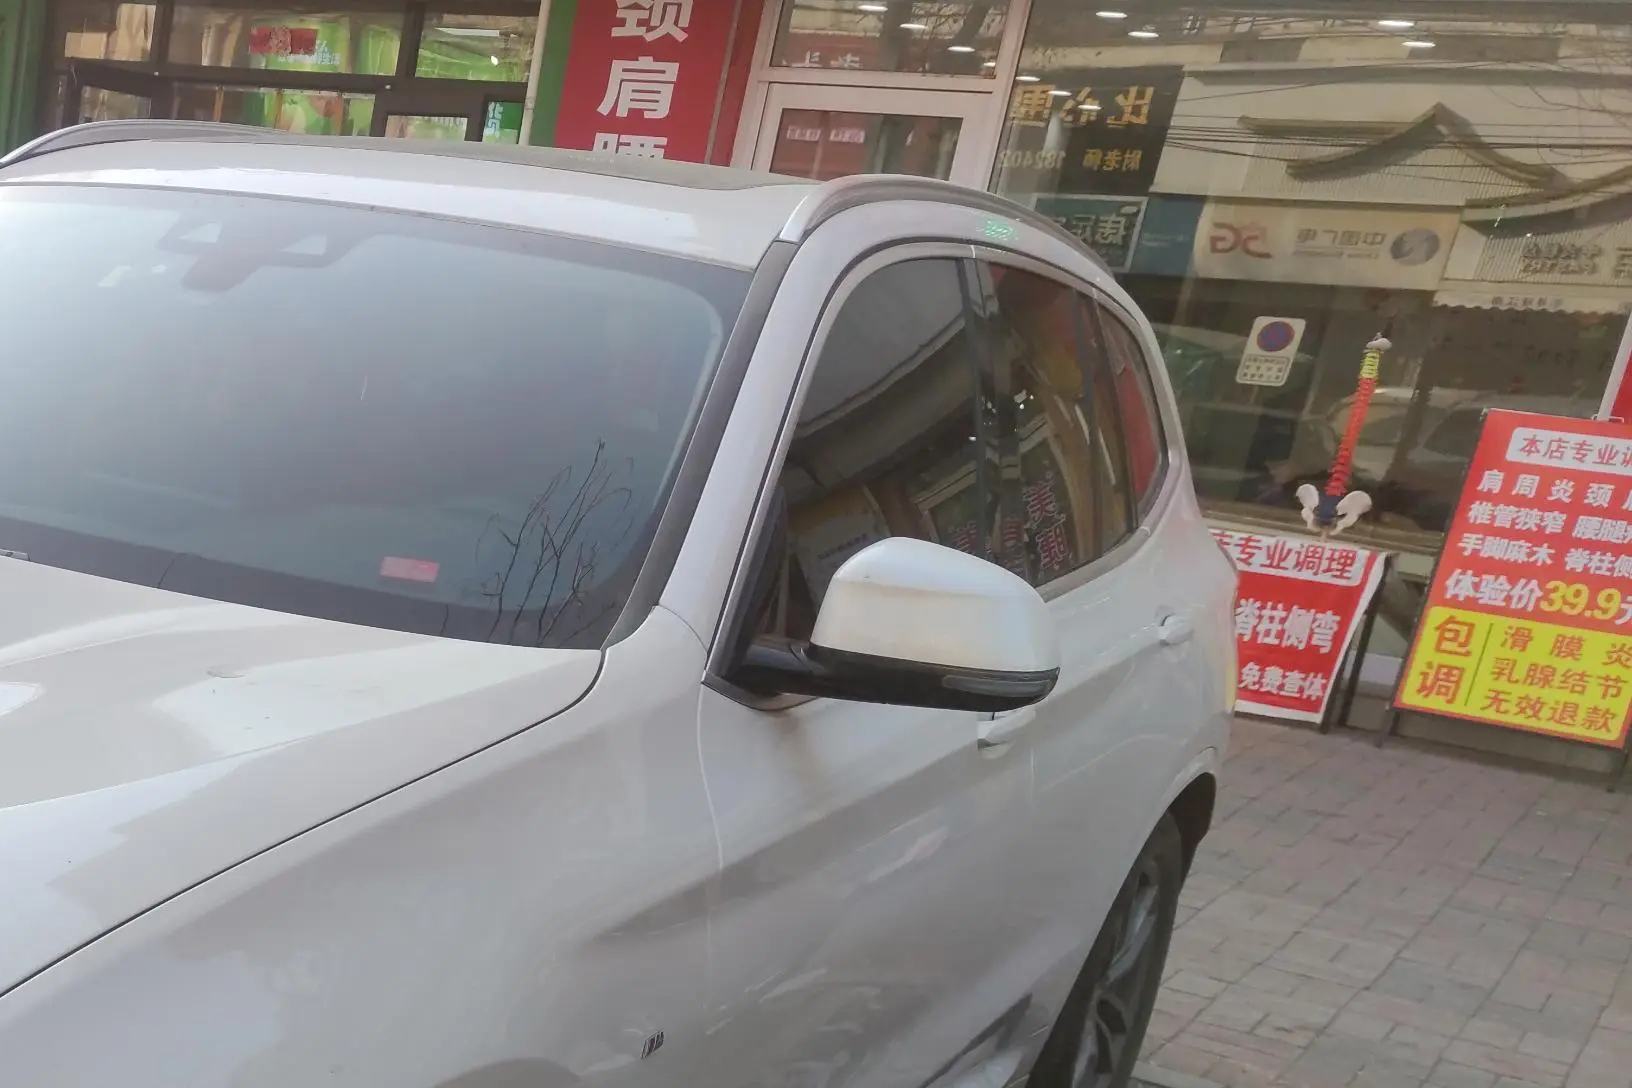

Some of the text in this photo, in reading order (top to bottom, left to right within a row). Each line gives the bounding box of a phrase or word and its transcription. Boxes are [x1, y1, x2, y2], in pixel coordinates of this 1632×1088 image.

[1468, 500, 1567, 534] 椎管狭窄
[1457, 532, 1555, 566] 手脚麻木
[1235, 598, 1341, 654] 脊柱侧弯
[1500, 625, 1632, 670] 滑膜炎
[1238, 662, 1329, 700] 免费查体
[1416, 615, 1476, 704] 包调
[1490, 657, 1628, 700] 乳腺结节
[1480, 688, 1618, 733] 无效退款
